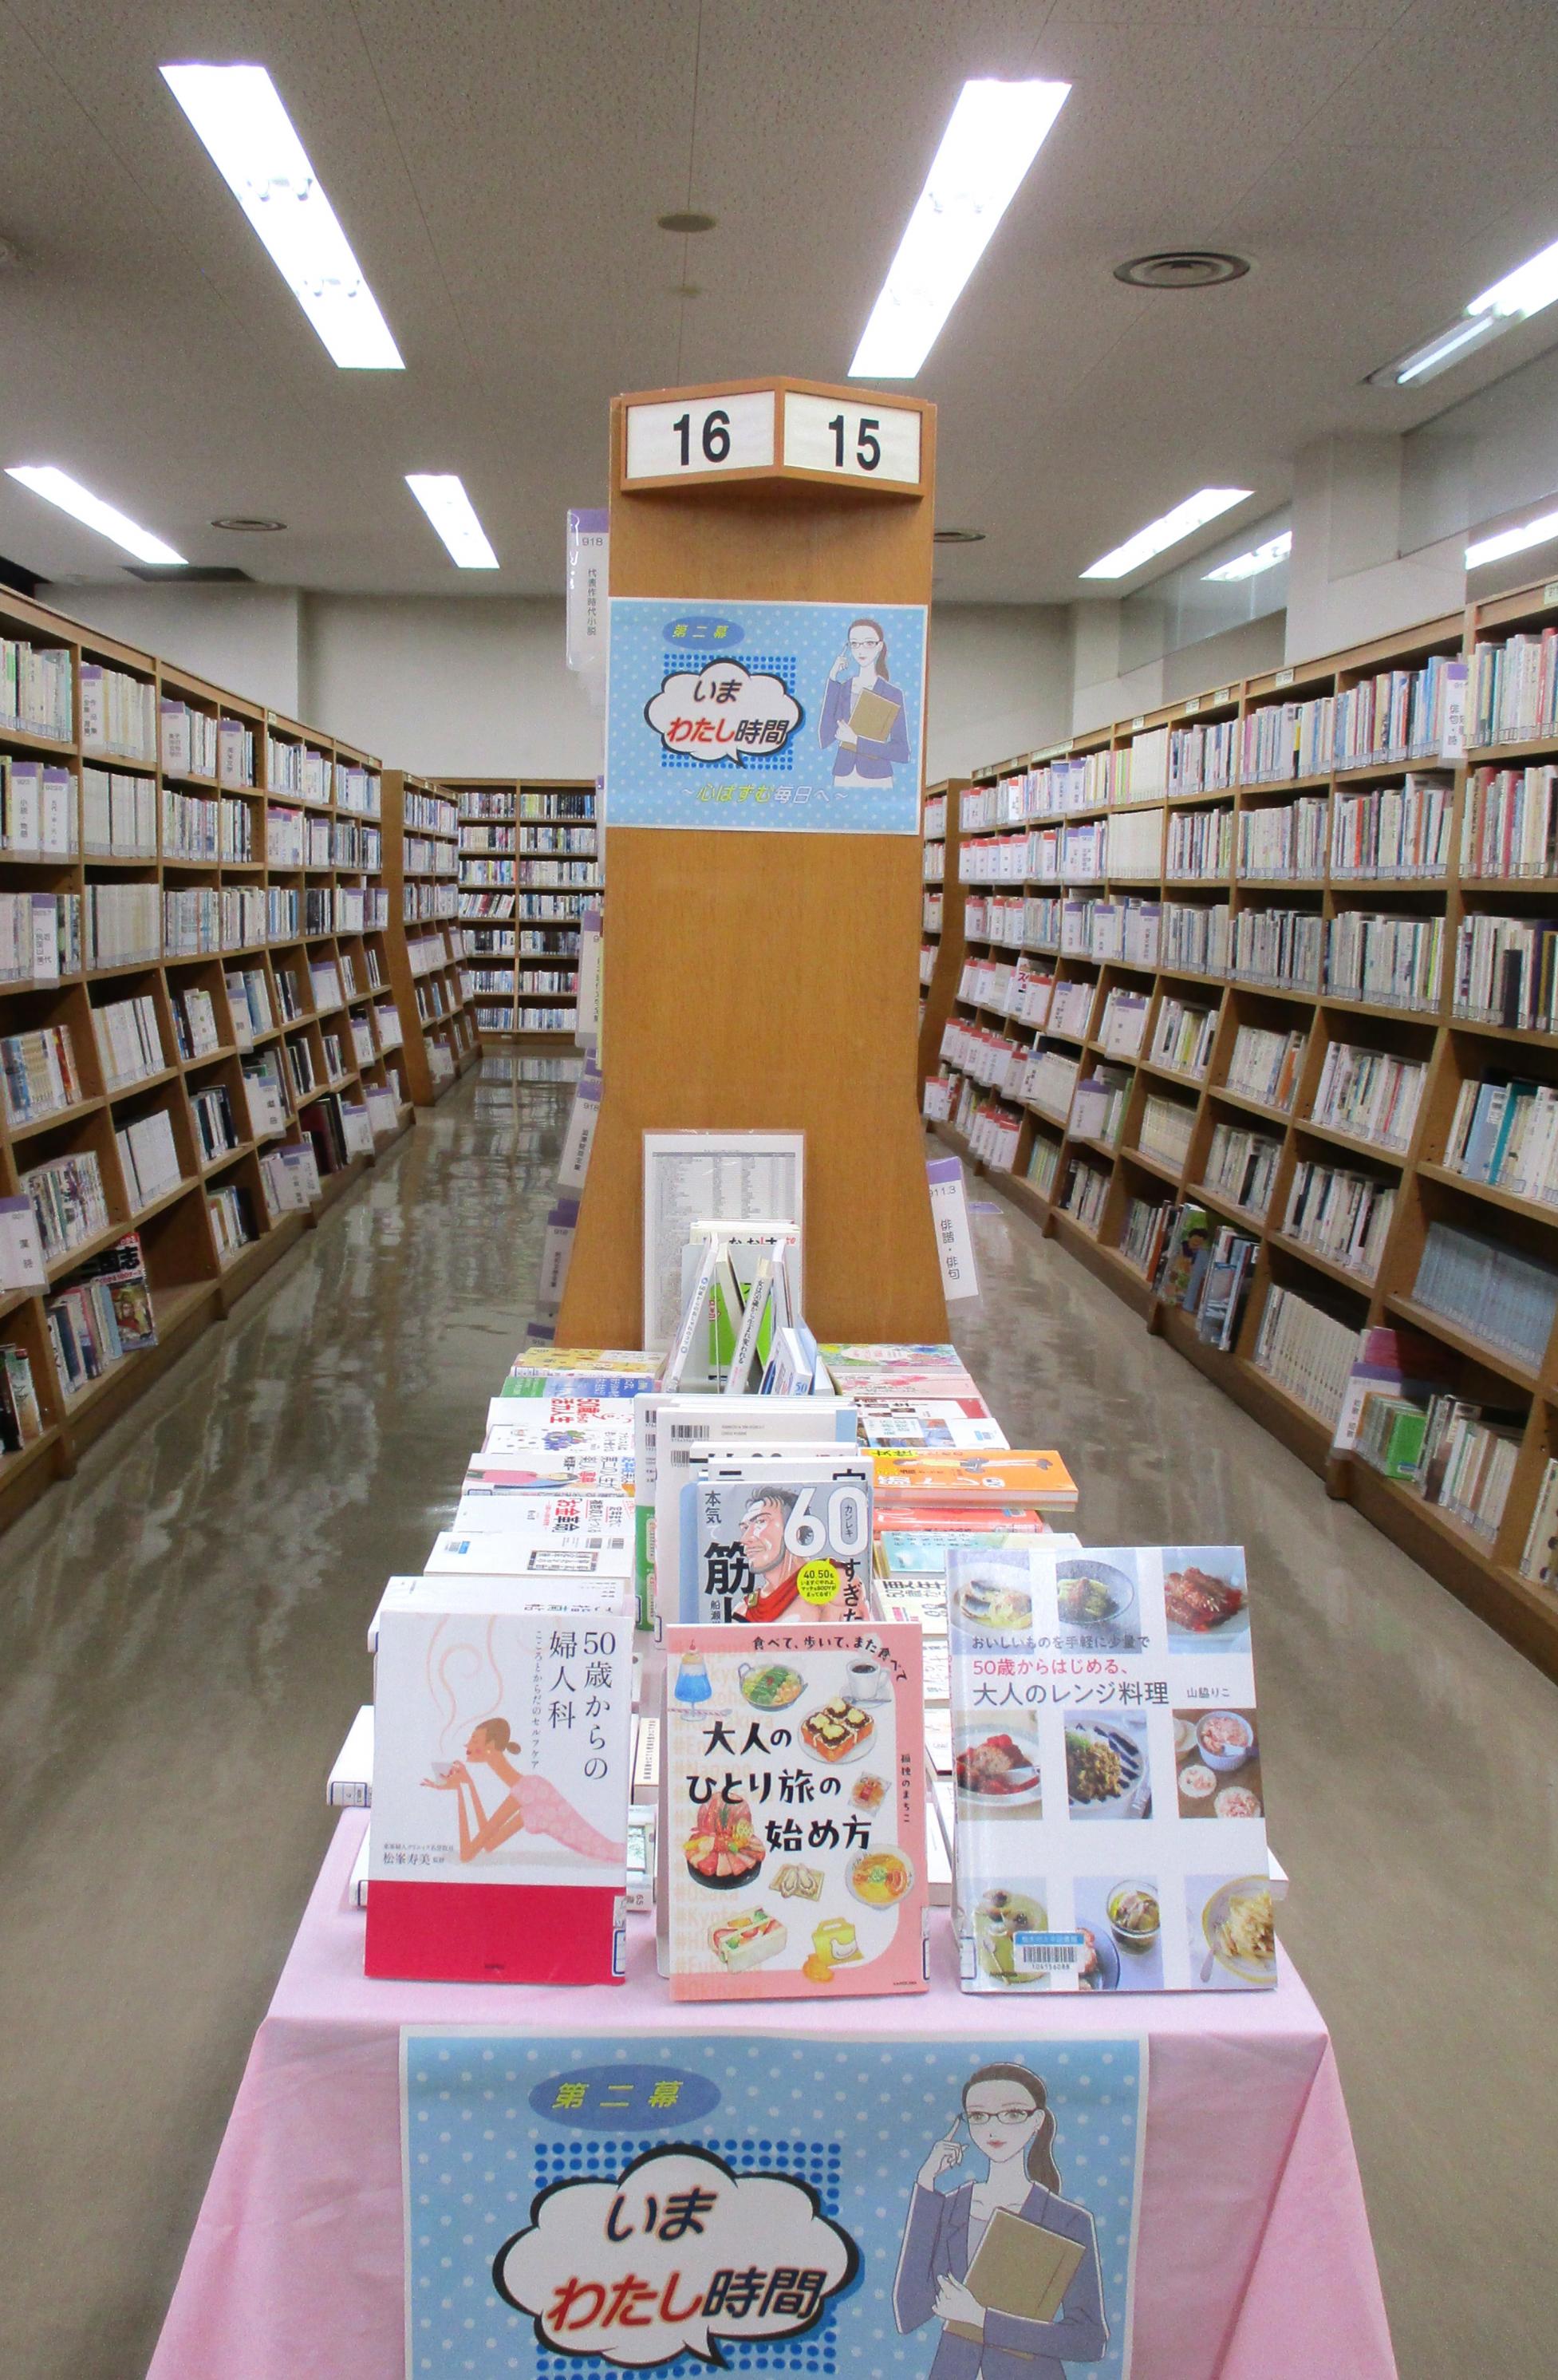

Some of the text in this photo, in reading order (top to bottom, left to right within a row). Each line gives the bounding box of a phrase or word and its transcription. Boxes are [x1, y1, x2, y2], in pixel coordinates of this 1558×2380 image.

[673, 410, 730, 466] 16
[828, 414, 881, 471] 15
[582, 537, 603, 547] 918
[587, 568, 597, 637] 代表作時代小説
[673, 623, 731, 639] 第二幕
[693, 678, 742, 704] いま
[667, 716, 790, 746] わたし時間
[549, 1397, 574, 1424] 活力人生
[704, 1490, 722, 1541] 本気で
[783, 1486, 868, 1557] 60
[843, 1505, 854, 1538] カンレキ
[711, 1600, 721, 1623] 船瀬
[752, 1636, 908, 1682] 食べて、歩いて、また食べて
[972, 1636, 1150, 1650] おいしいものを手軽に少量で
[547, 1630, 578, 1730] 婦人科
[972, 1658, 1130, 1676] 50歳からはじめる、
[531, 1630, 544, 1770] こころとからだのセルフケア
[582, 1631, 617, 1780] 50歳からの
[972, 1681, 1169, 1706] 大人のレンジ料理
[1186, 1685, 1232, 1699] 山脇りこ
[704, 1720, 792, 1756] 大人の
[686, 1768, 842, 1806] ひとり旅の
[764, 1815, 873, 1853] 始め方
[551, 2078, 684, 2110] 第二幕
[603, 2187, 720, 2243] いま
[546, 2266, 827, 2334] わたし時間
